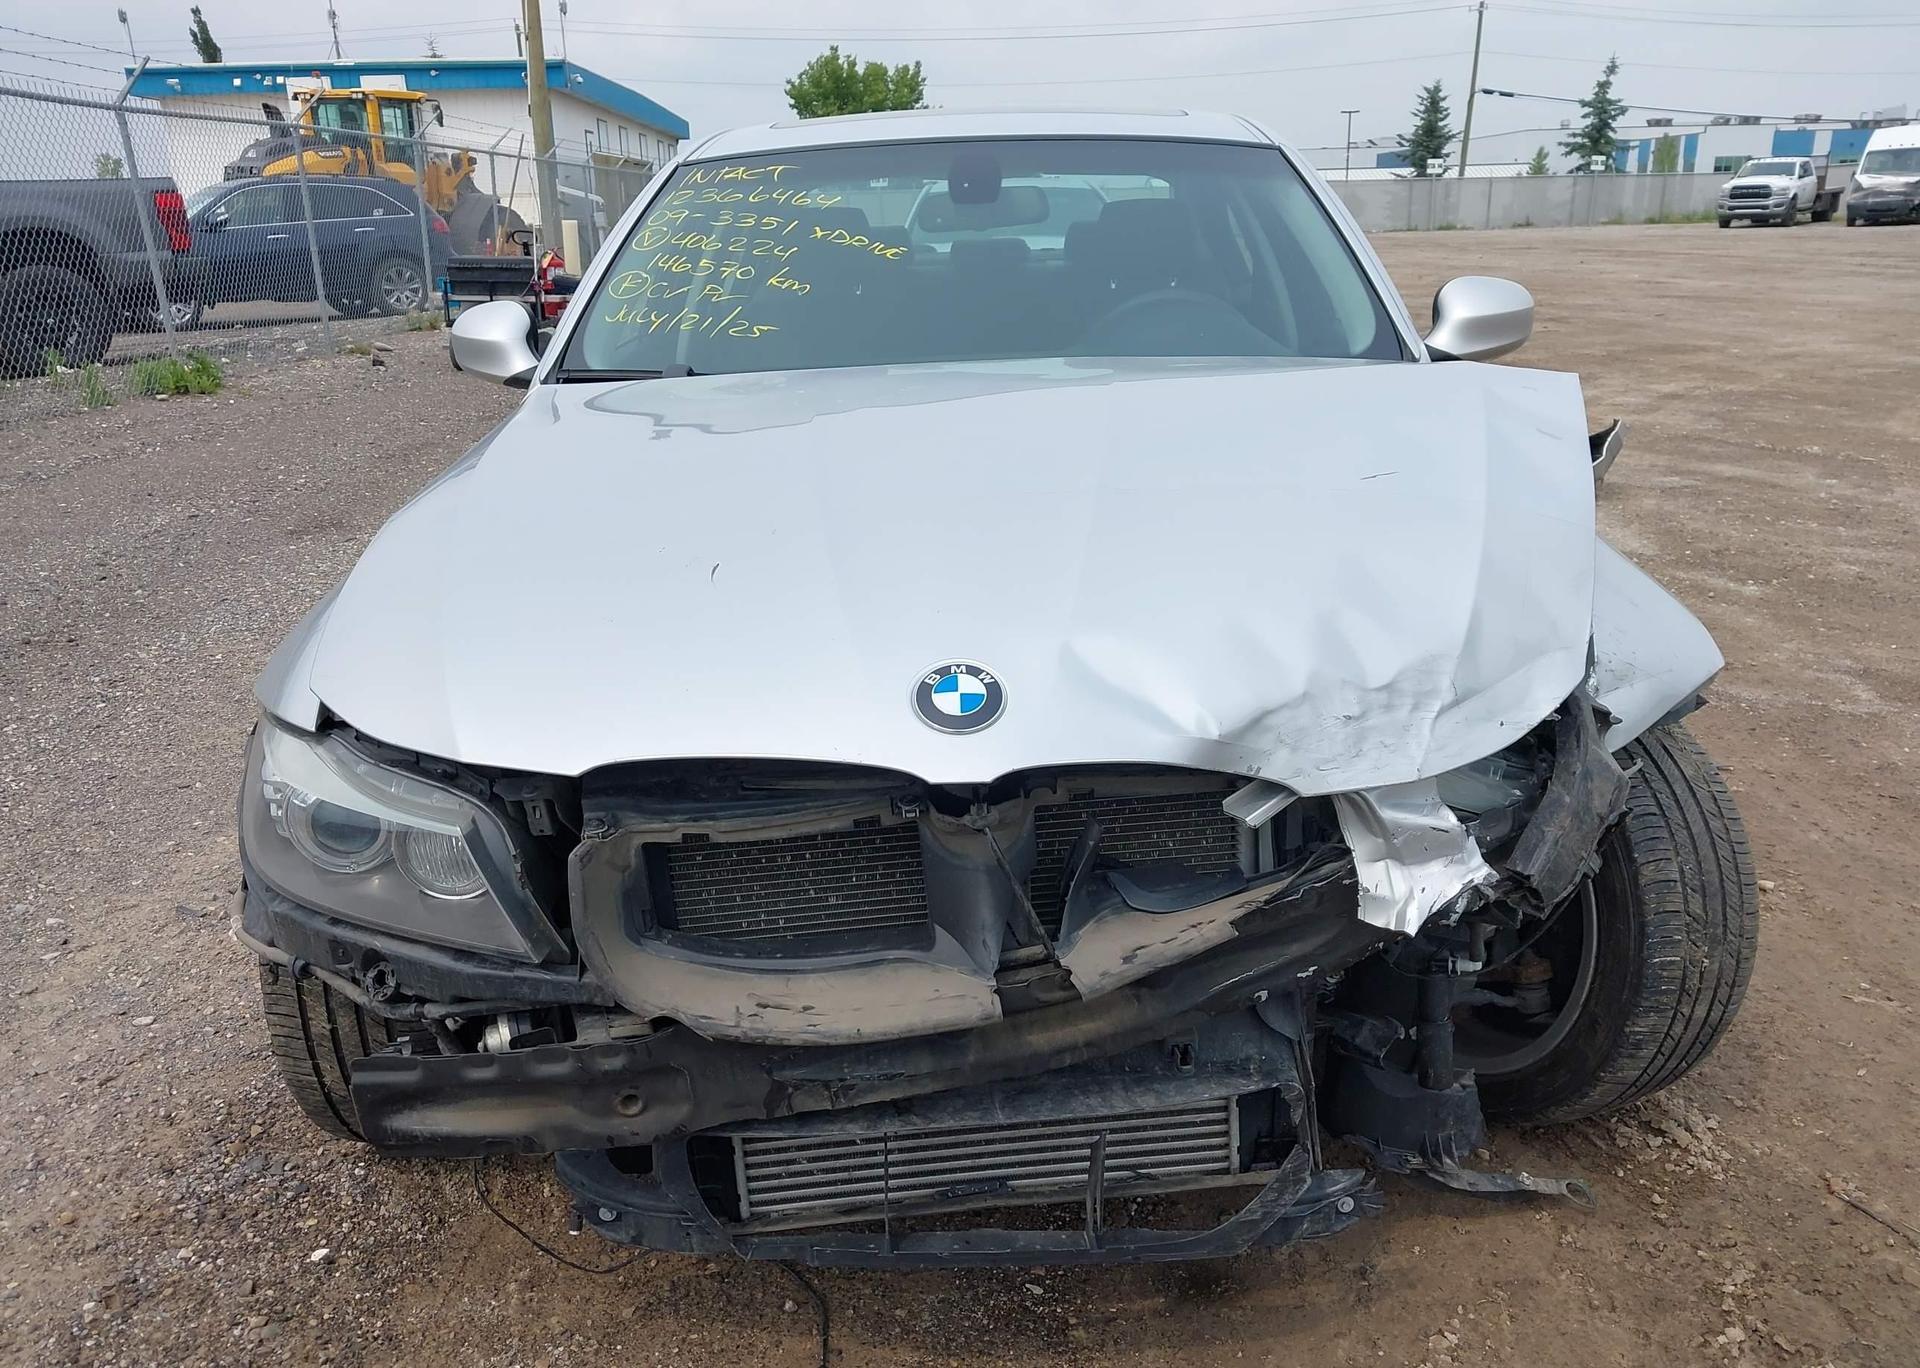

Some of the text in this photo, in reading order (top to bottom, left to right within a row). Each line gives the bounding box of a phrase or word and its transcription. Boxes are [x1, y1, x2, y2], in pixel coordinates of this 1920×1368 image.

[680, 165, 801, 188] INTACT
[663, 186, 841, 210] 12366464
[671, 231, 799, 262] 406224
[647, 252, 755, 279] 146570
[923, 664, 995, 684] BMW
